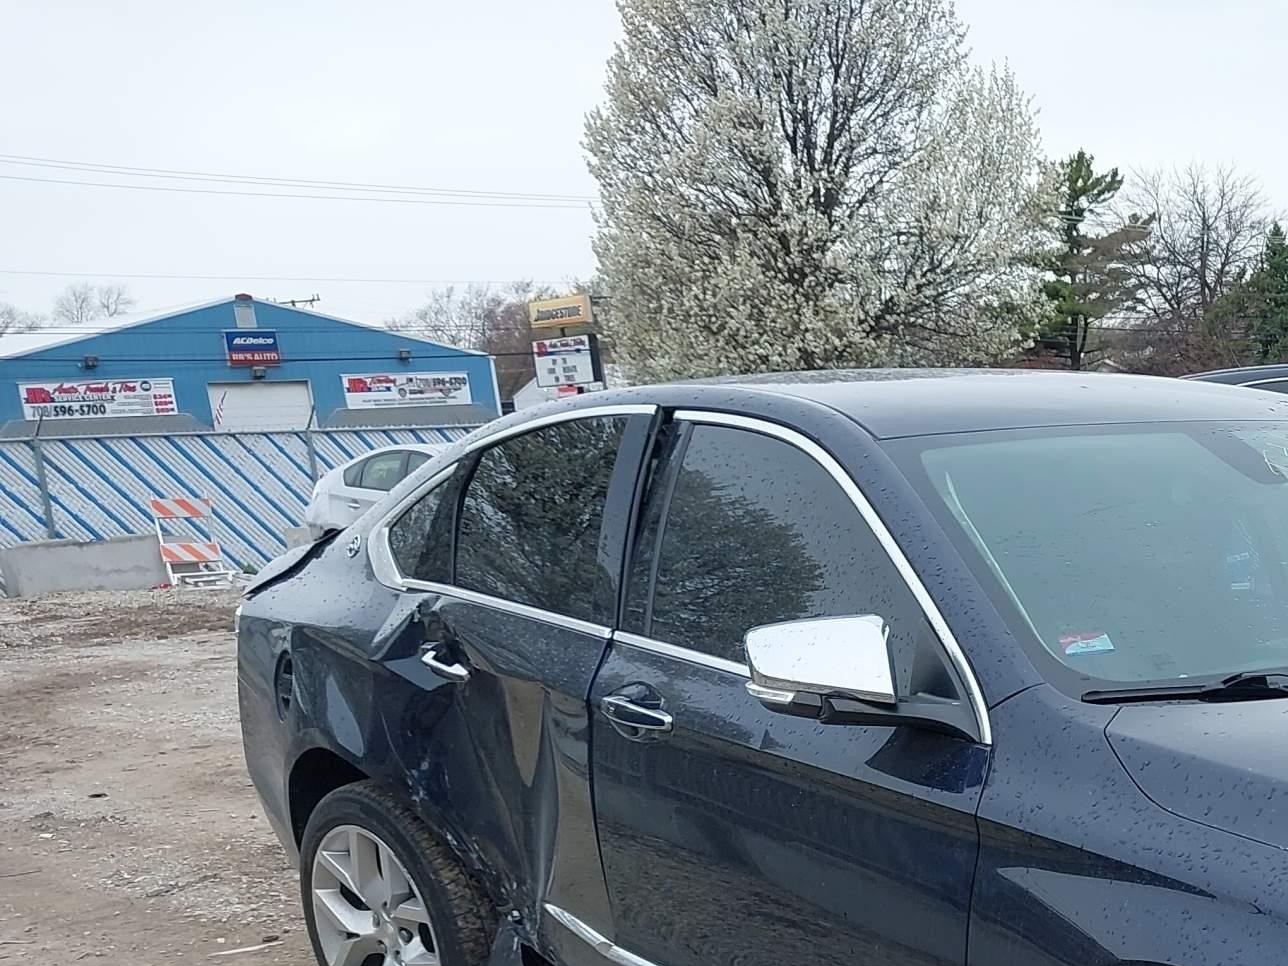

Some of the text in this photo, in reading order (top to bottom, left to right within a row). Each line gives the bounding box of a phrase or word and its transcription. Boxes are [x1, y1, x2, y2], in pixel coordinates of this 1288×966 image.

[233, 336, 275, 345] ACDelco
[254, 352, 278, 361] AUTO
[54, 393, 112, 402] SERVICE CENTER
[31, 403, 107, 418] 708/596-5700
